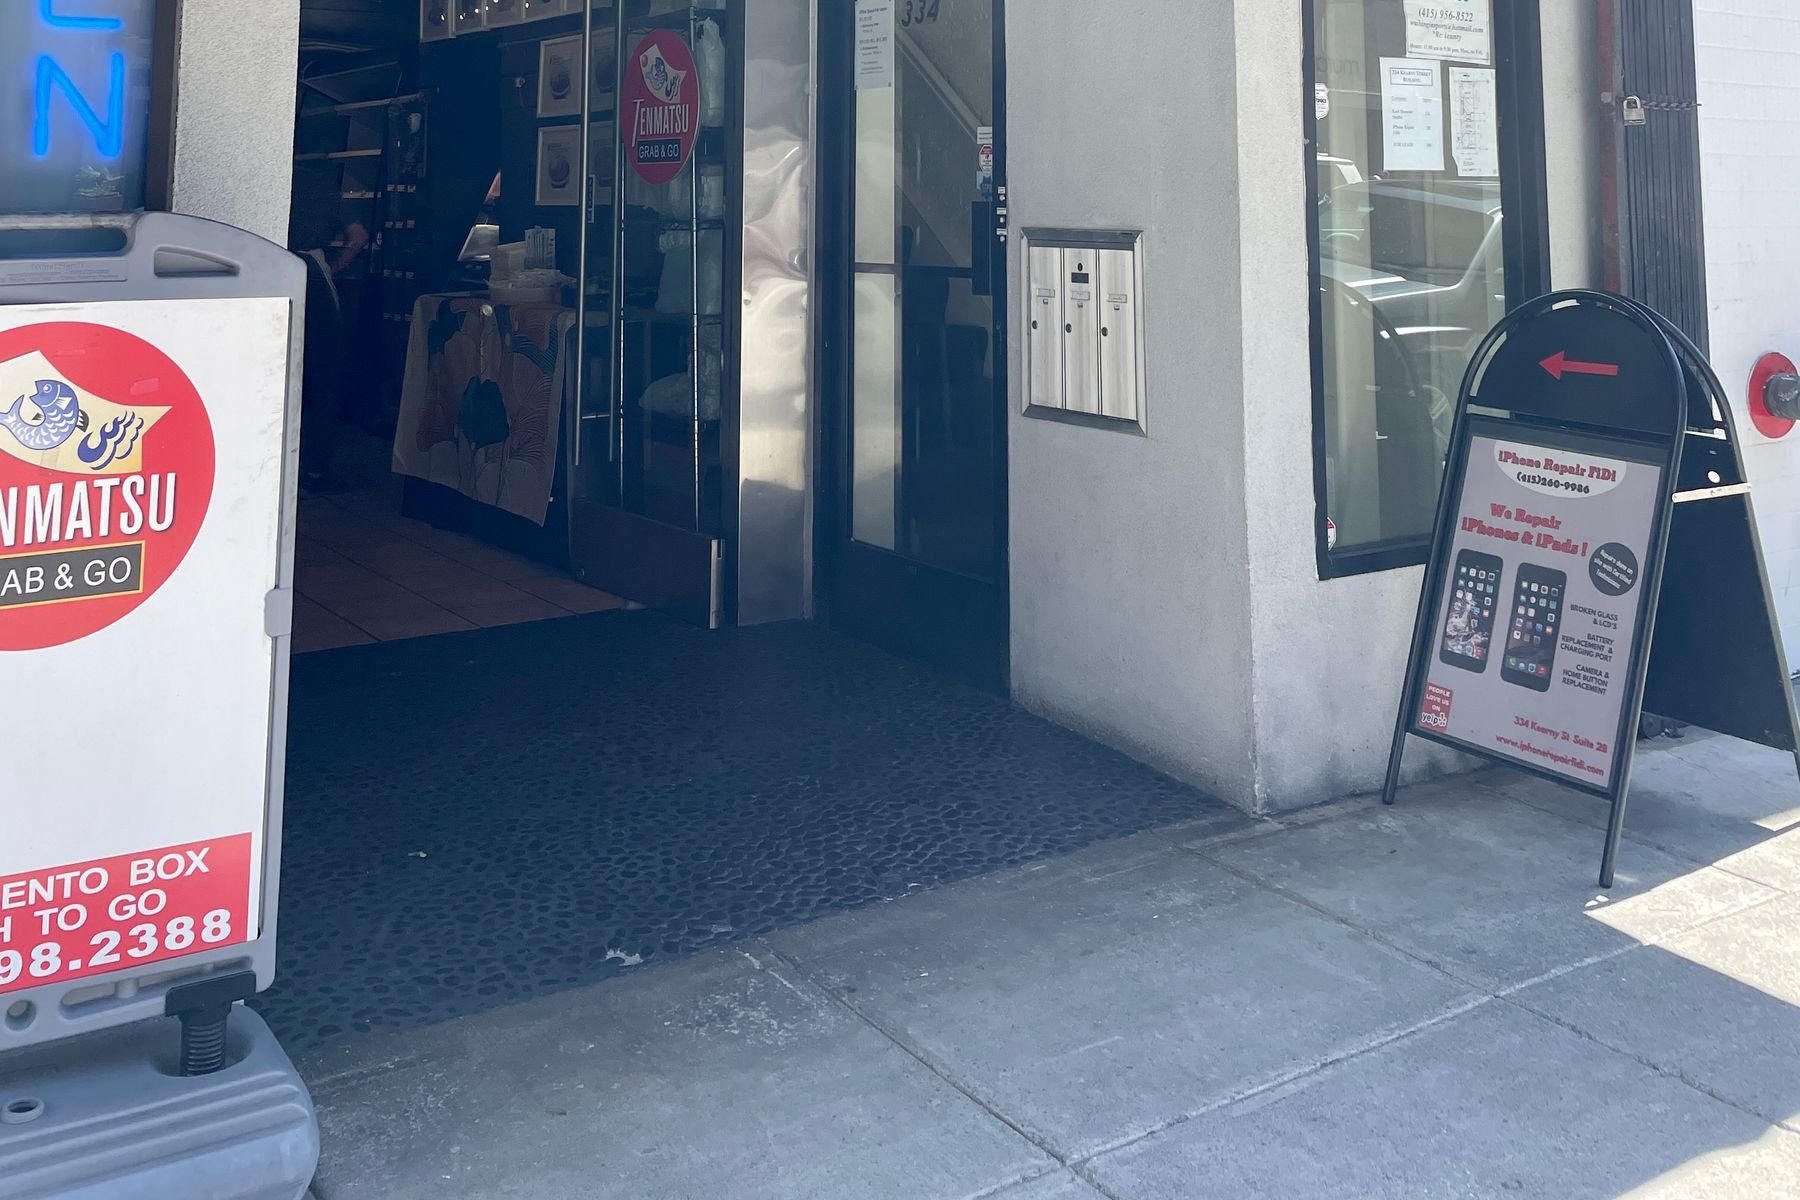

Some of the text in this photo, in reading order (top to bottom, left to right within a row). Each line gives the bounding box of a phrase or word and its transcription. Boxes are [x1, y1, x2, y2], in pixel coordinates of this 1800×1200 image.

[1419, 8, 1437, 19] (415)
[632, 98, 689, 147] TENMATSU
[639, 144, 679, 158] GRAB & GO
[1498, 450, 1541, 468] iPhone
[1543, 458, 1586, 477] Repair
[1490, 502, 1561, 529] We Repair
[1461, 516, 1519, 541] iPhones
[1521, 531, 1534, 545] &
[54, 563, 74, 589] &
[84, 557, 131, 584] GO
[1570, 604, 1619, 622] BROKEN GLASS
[1562, 635, 1605, 650] REPLACEMENT
[1587, 633, 1615, 645] BATTERY
[1560, 643, 1612, 662] CHARGING PORT
[1562, 669, 1608, 687] HOME BUTTON
[1576, 664, 1603, 678] CAMERA
[1428, 686, 1450, 697] PEOPLE
[1562, 677, 1607, 695] REPLACEMENT
[1422, 712, 1438, 726] yelp
[1513, 716, 1529, 728] 334
[2, 847, 210, 910] ENTO BOX
[34, 903, 88, 936] TO
[108, 888, 167, 922] GO
[0, 908, 231, 985] 98.2388
